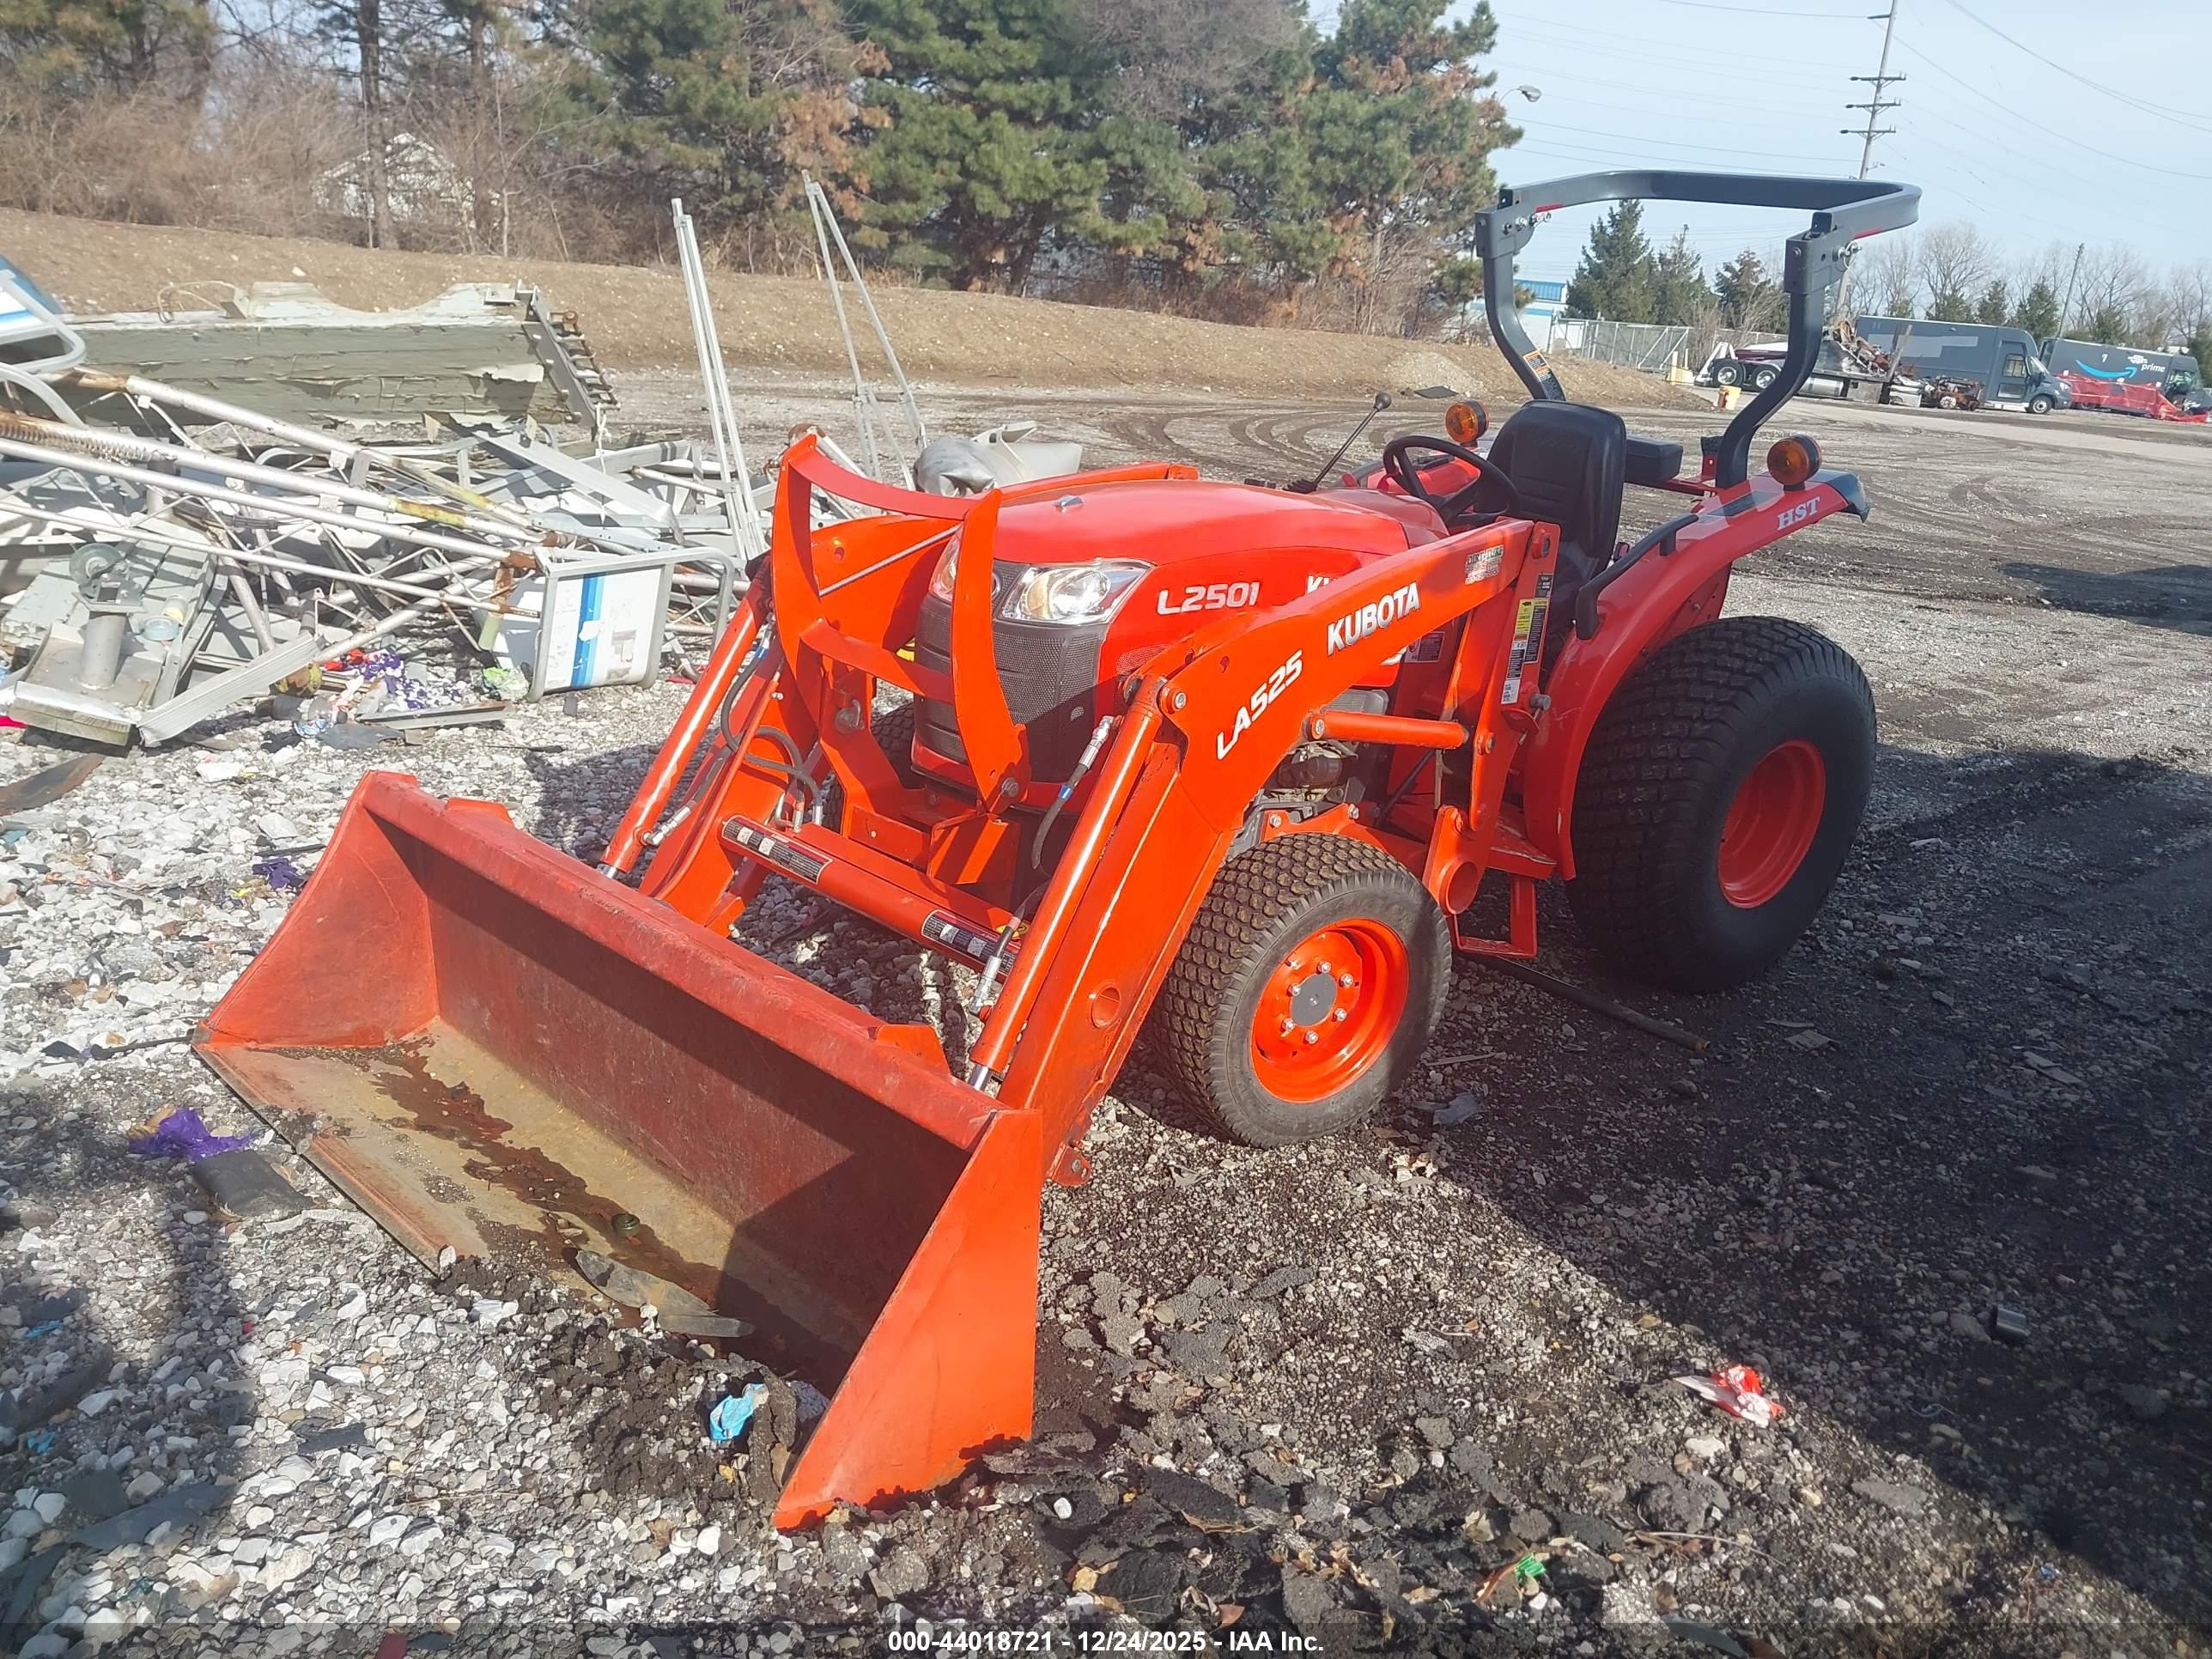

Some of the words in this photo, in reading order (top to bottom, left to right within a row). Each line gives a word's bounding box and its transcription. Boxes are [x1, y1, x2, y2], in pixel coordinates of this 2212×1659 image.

[2141, 362, 2166, 373] prime
[1778, 496, 1820, 531] HST
[1157, 581, 1261, 616] L2501
[1327, 581, 1421, 657] KUBOTA
[1216, 649, 1304, 760] LA525
